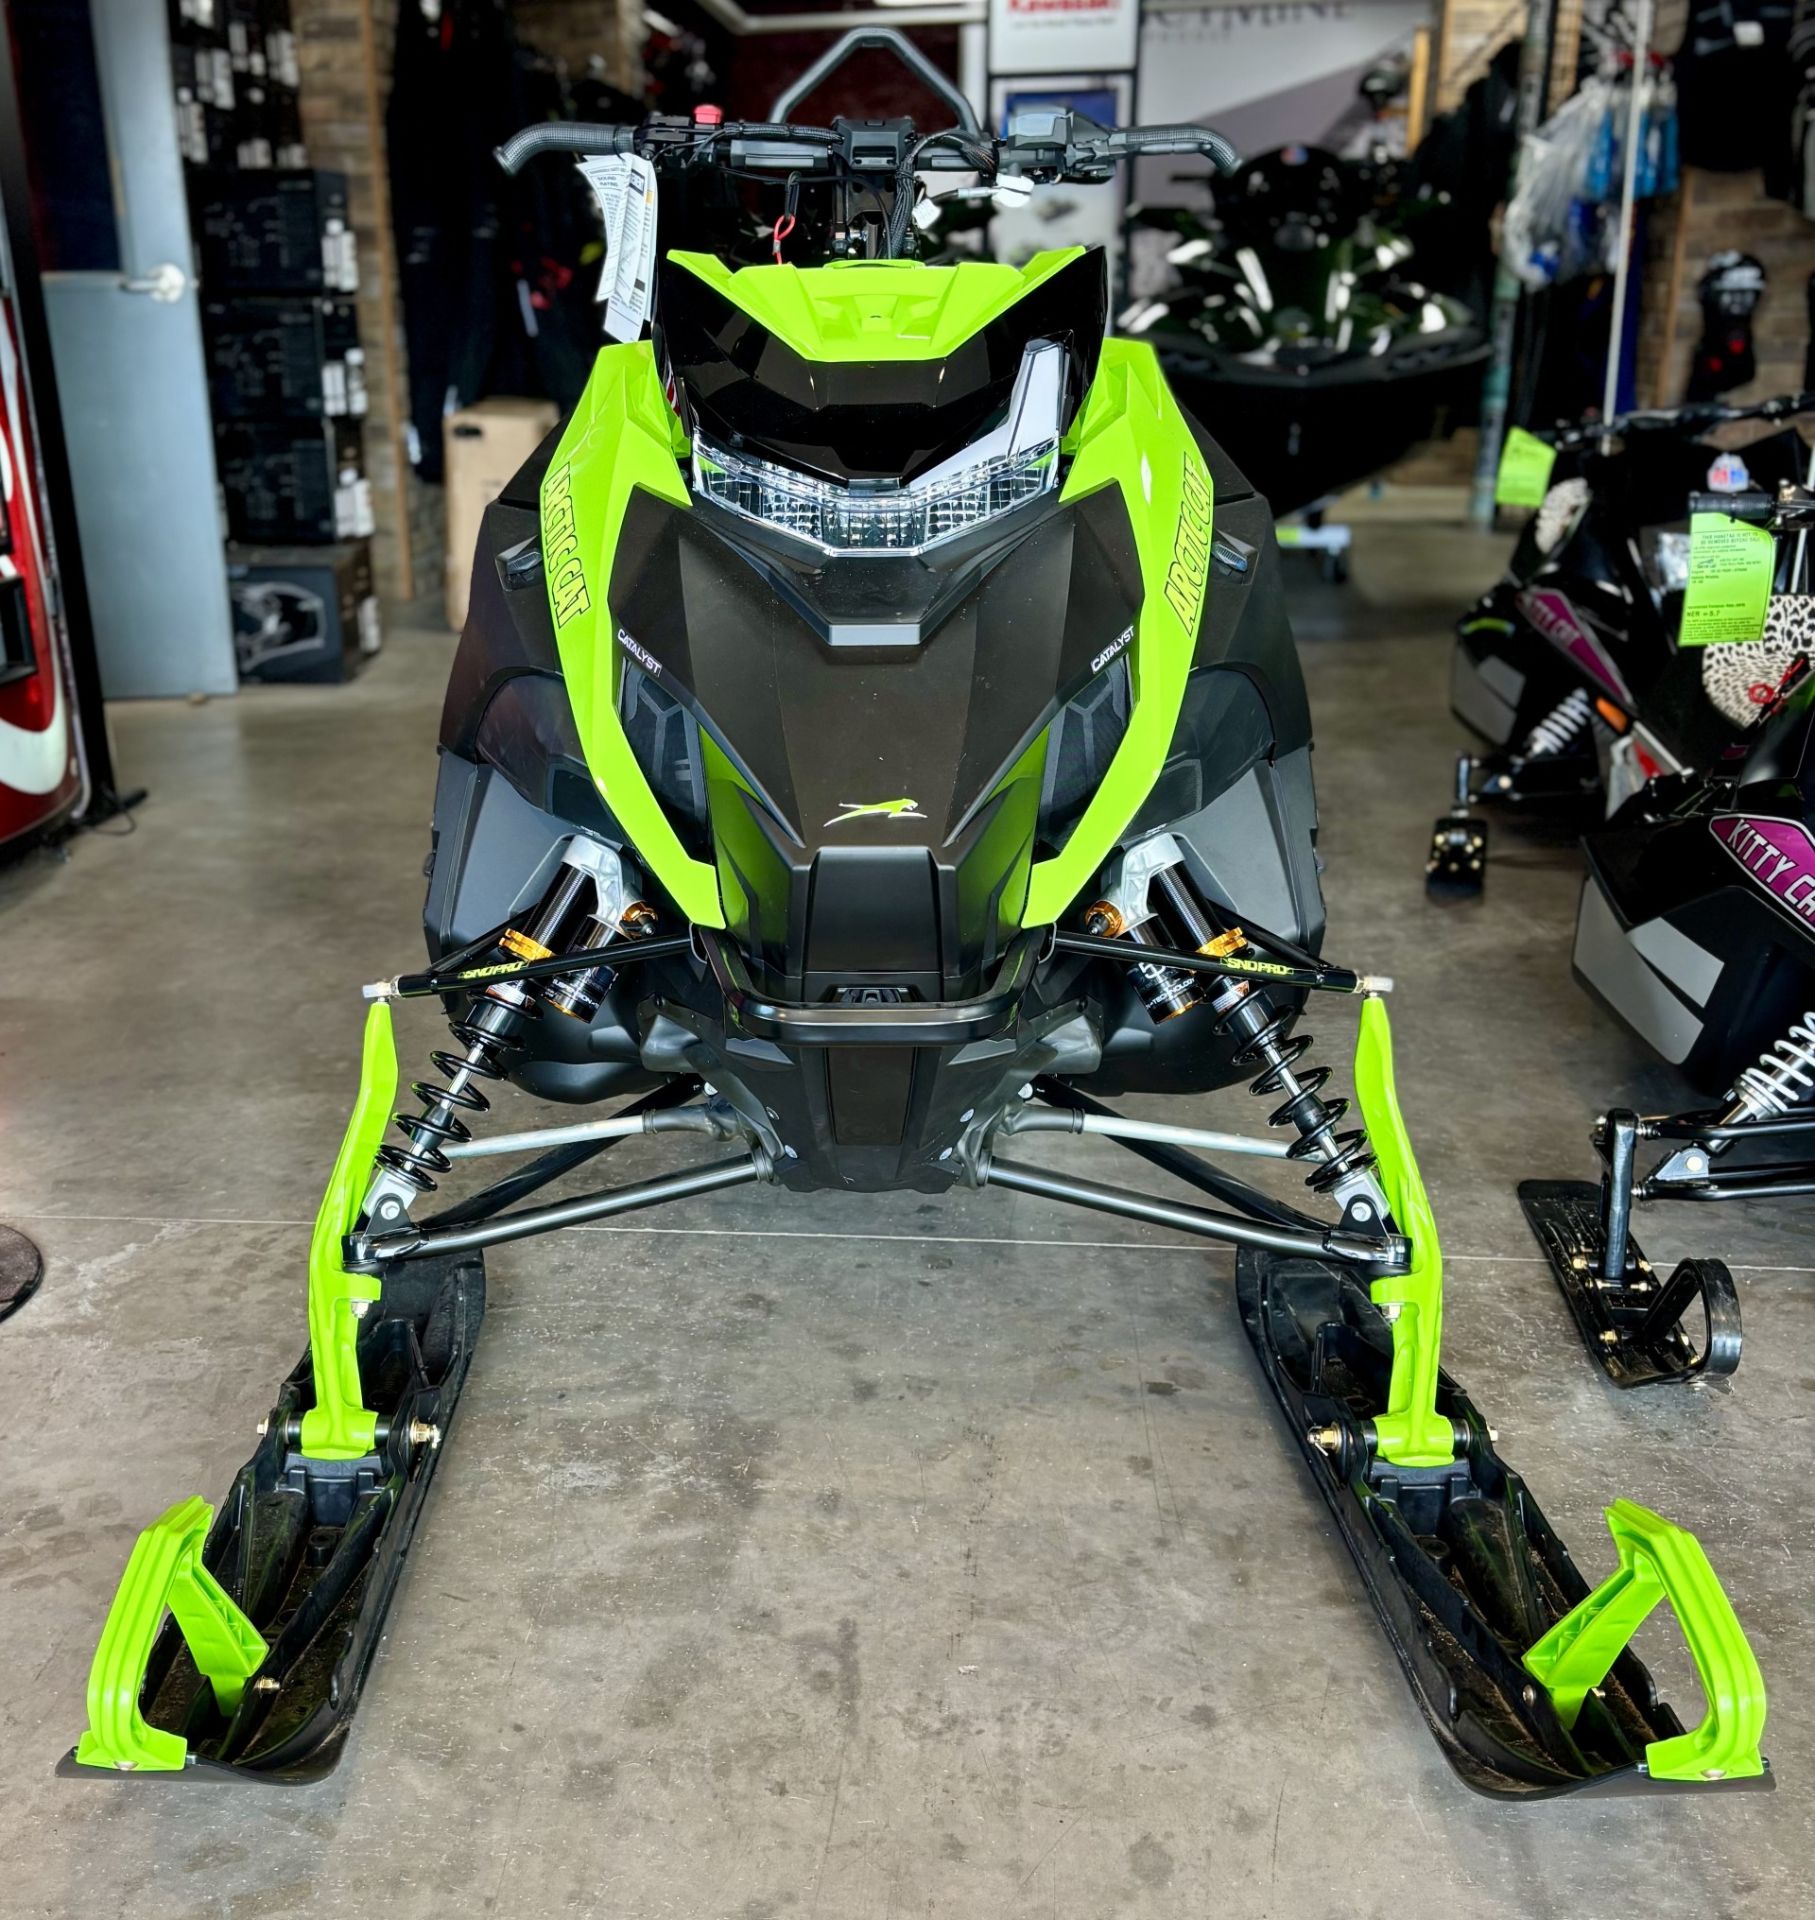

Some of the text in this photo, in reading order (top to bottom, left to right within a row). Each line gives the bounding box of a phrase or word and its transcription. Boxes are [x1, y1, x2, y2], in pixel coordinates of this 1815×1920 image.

[544, 461, 591, 629] ARCTIC CAT
[1164, 501, 1209, 638] ARCTIC
[617, 628, 661, 677] CATALYST
[1090, 625, 1135, 672] CATALYST
[1727, 818, 1815, 917] KITTY CA
